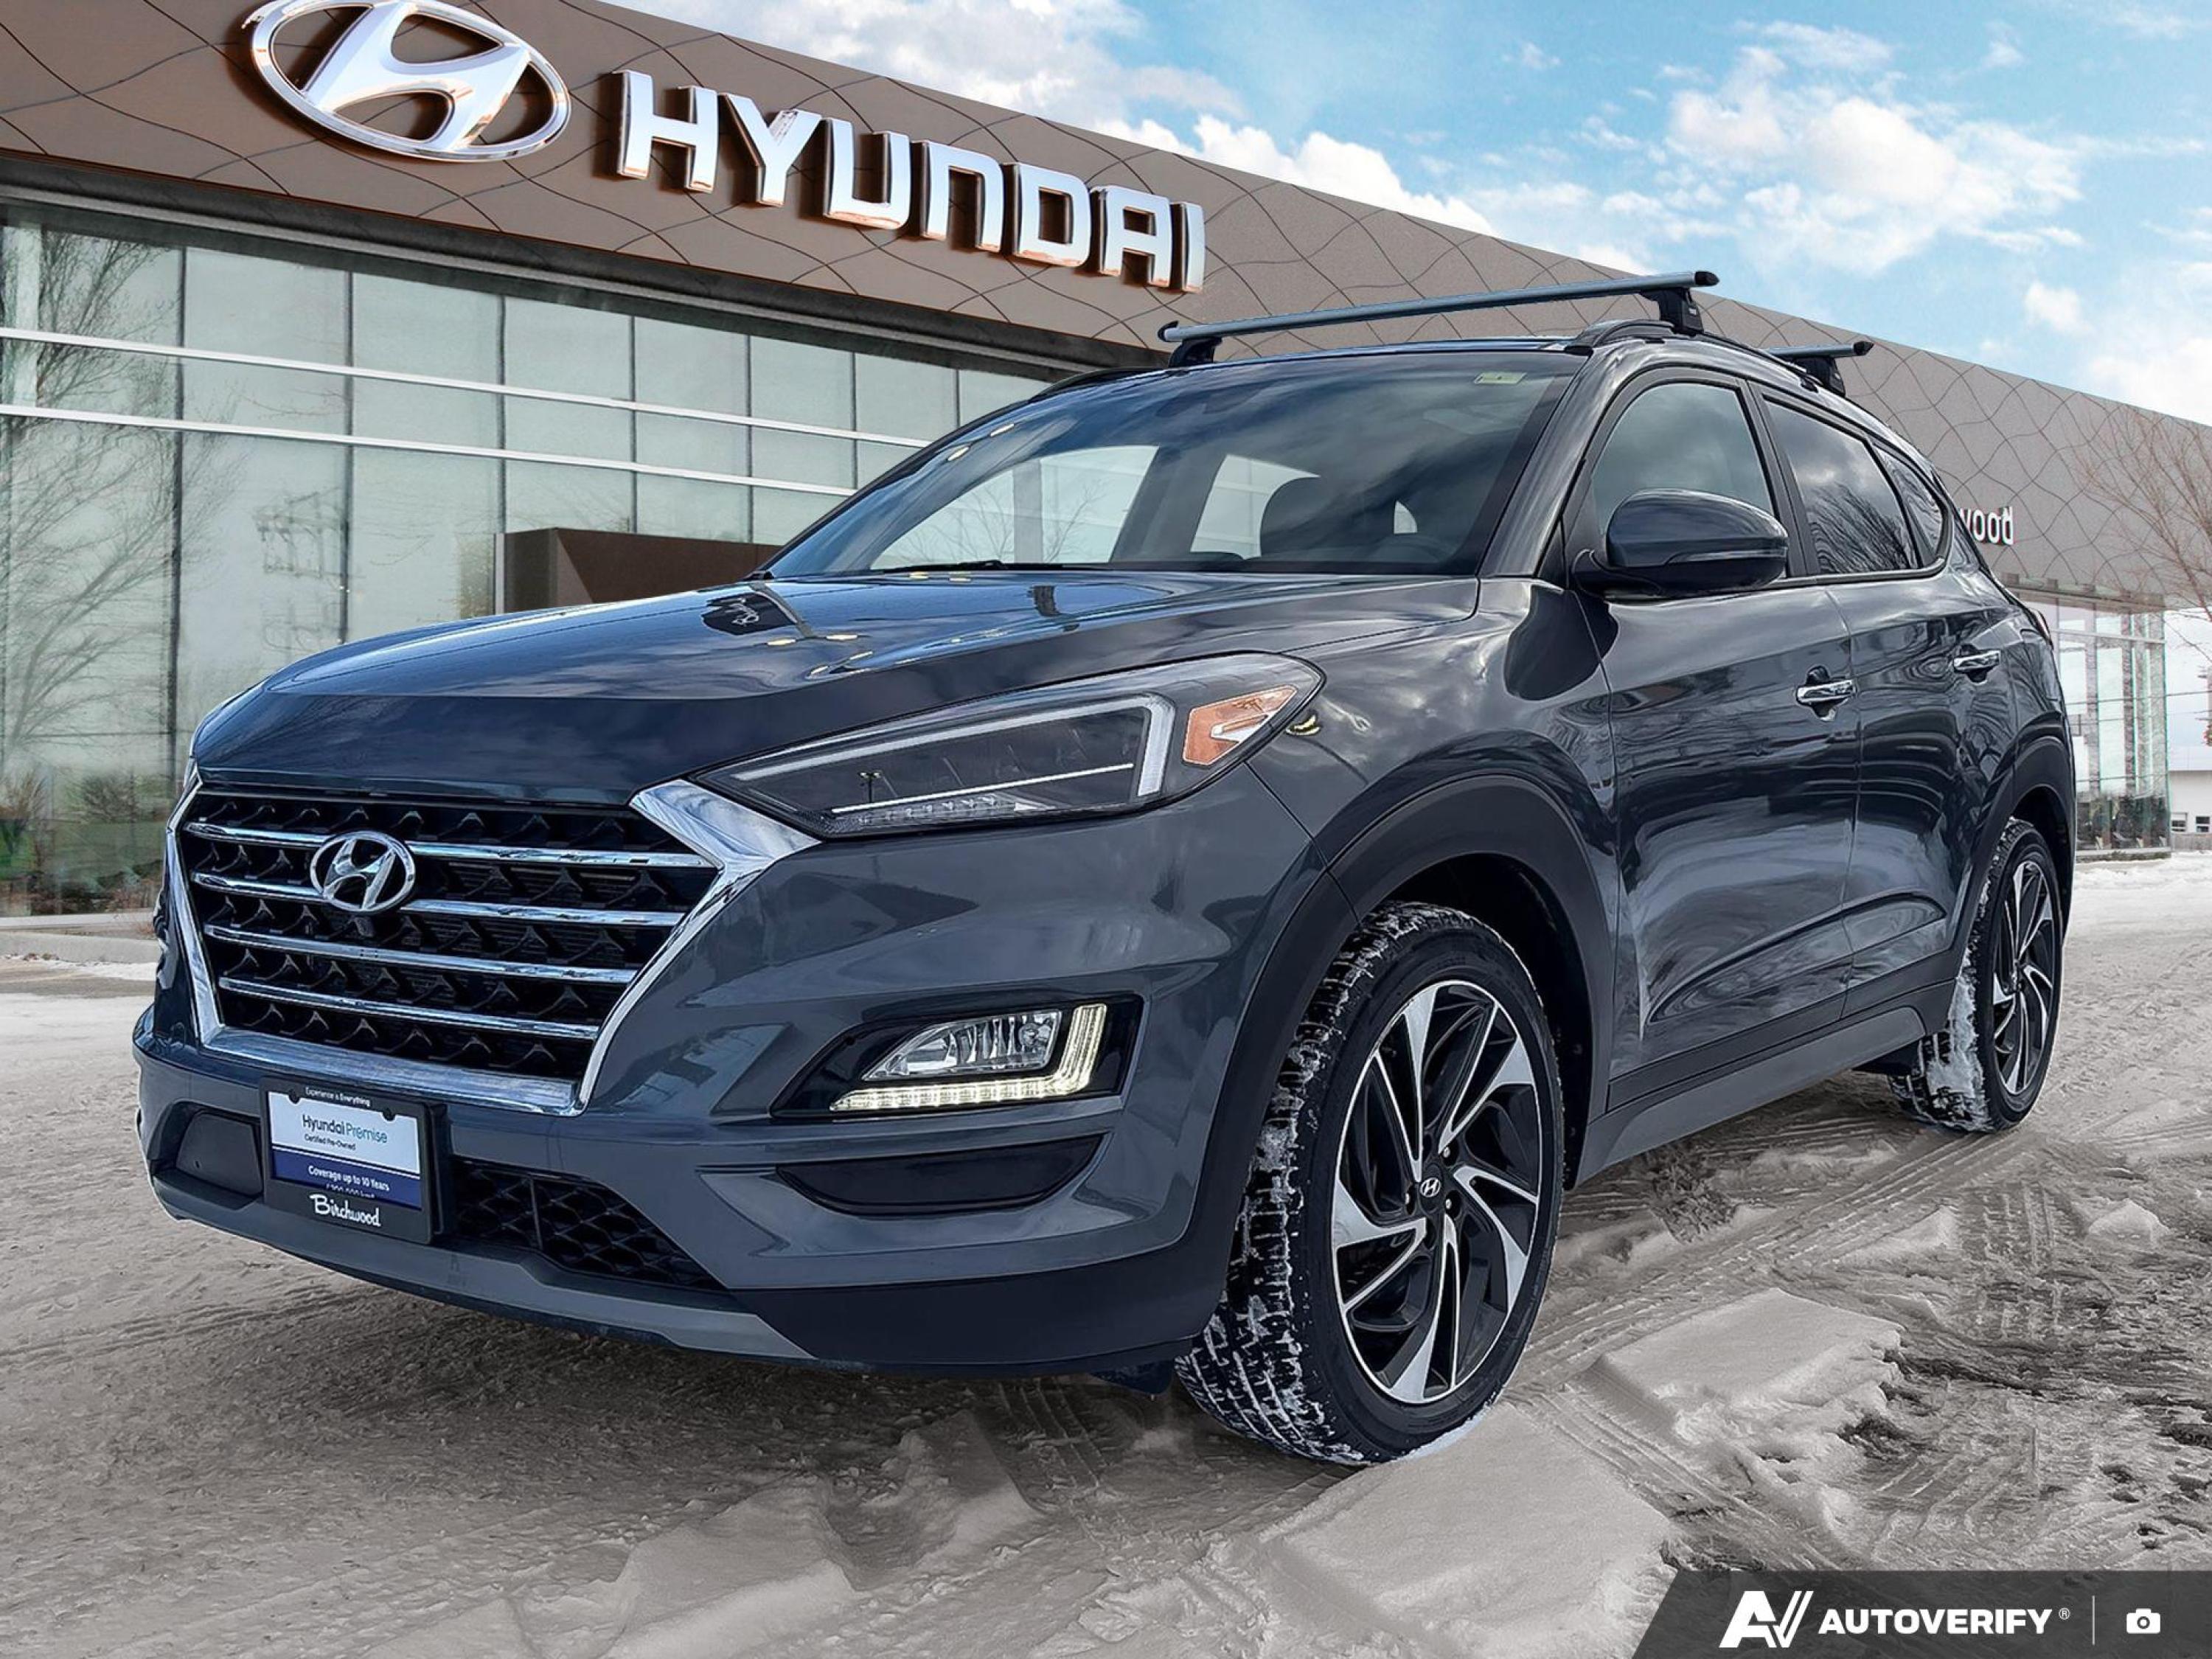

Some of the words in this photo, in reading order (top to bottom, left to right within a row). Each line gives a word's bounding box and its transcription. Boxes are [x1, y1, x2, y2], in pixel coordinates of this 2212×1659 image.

[615, 69, 1207, 293] HYUNDAI
[302, 1114, 344, 1135] Hyundai
[308, 1165, 341, 1183] Coverage
[342, 1174, 352, 1185] up
[352, 1175, 361, 1185] to
[361, 1177, 369, 1188] 10
[309, 1193, 382, 1228] Birchwood
